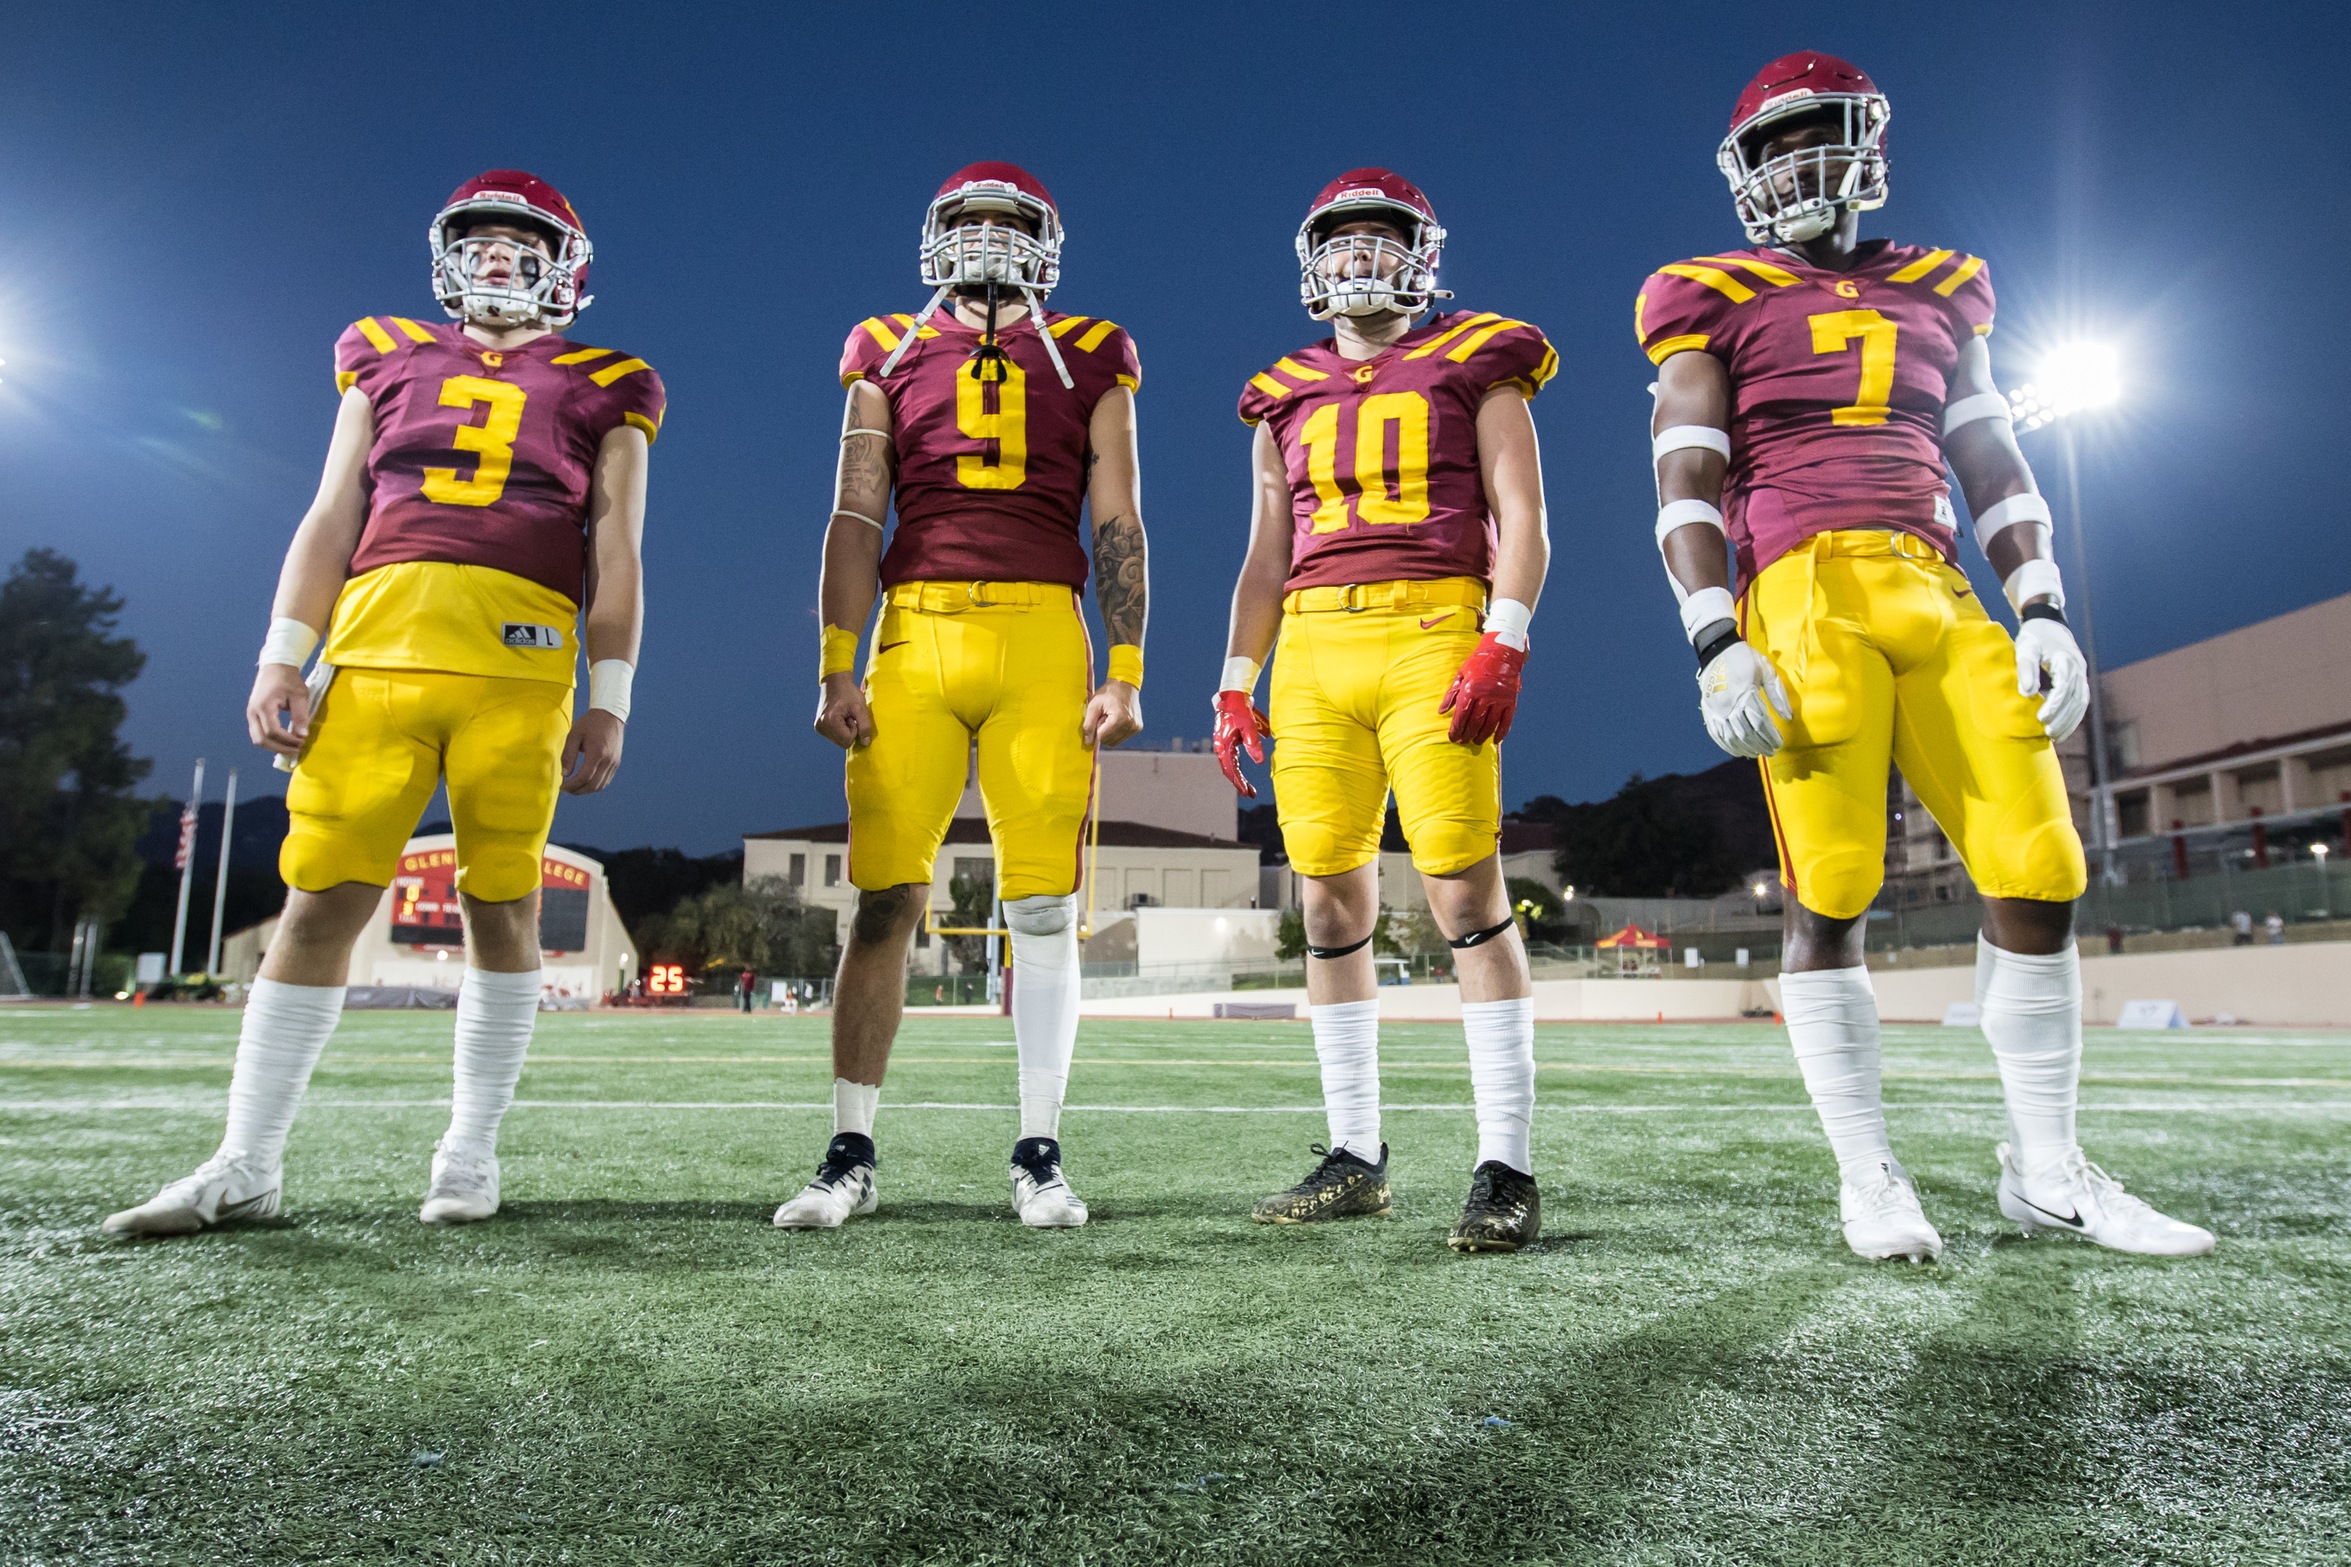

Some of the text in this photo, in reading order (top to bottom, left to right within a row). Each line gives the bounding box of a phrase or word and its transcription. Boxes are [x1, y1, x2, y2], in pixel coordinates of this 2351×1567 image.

[1340, 189, 1379, 199] Riddell
[1835, 280, 1860, 299] G
[480, 351, 503, 367] G
[1808, 309, 1898, 427] 7
[1353, 365, 1373, 383] G
[956, 358, 1028, 490] 9
[419, 374, 528, 507] 3
[1300, 391, 1431, 536] 10
[505, 627, 554, 646] adidas L
[404, 851, 586, 886] GLEN LEGE
[650, 965, 683, 992] 25
